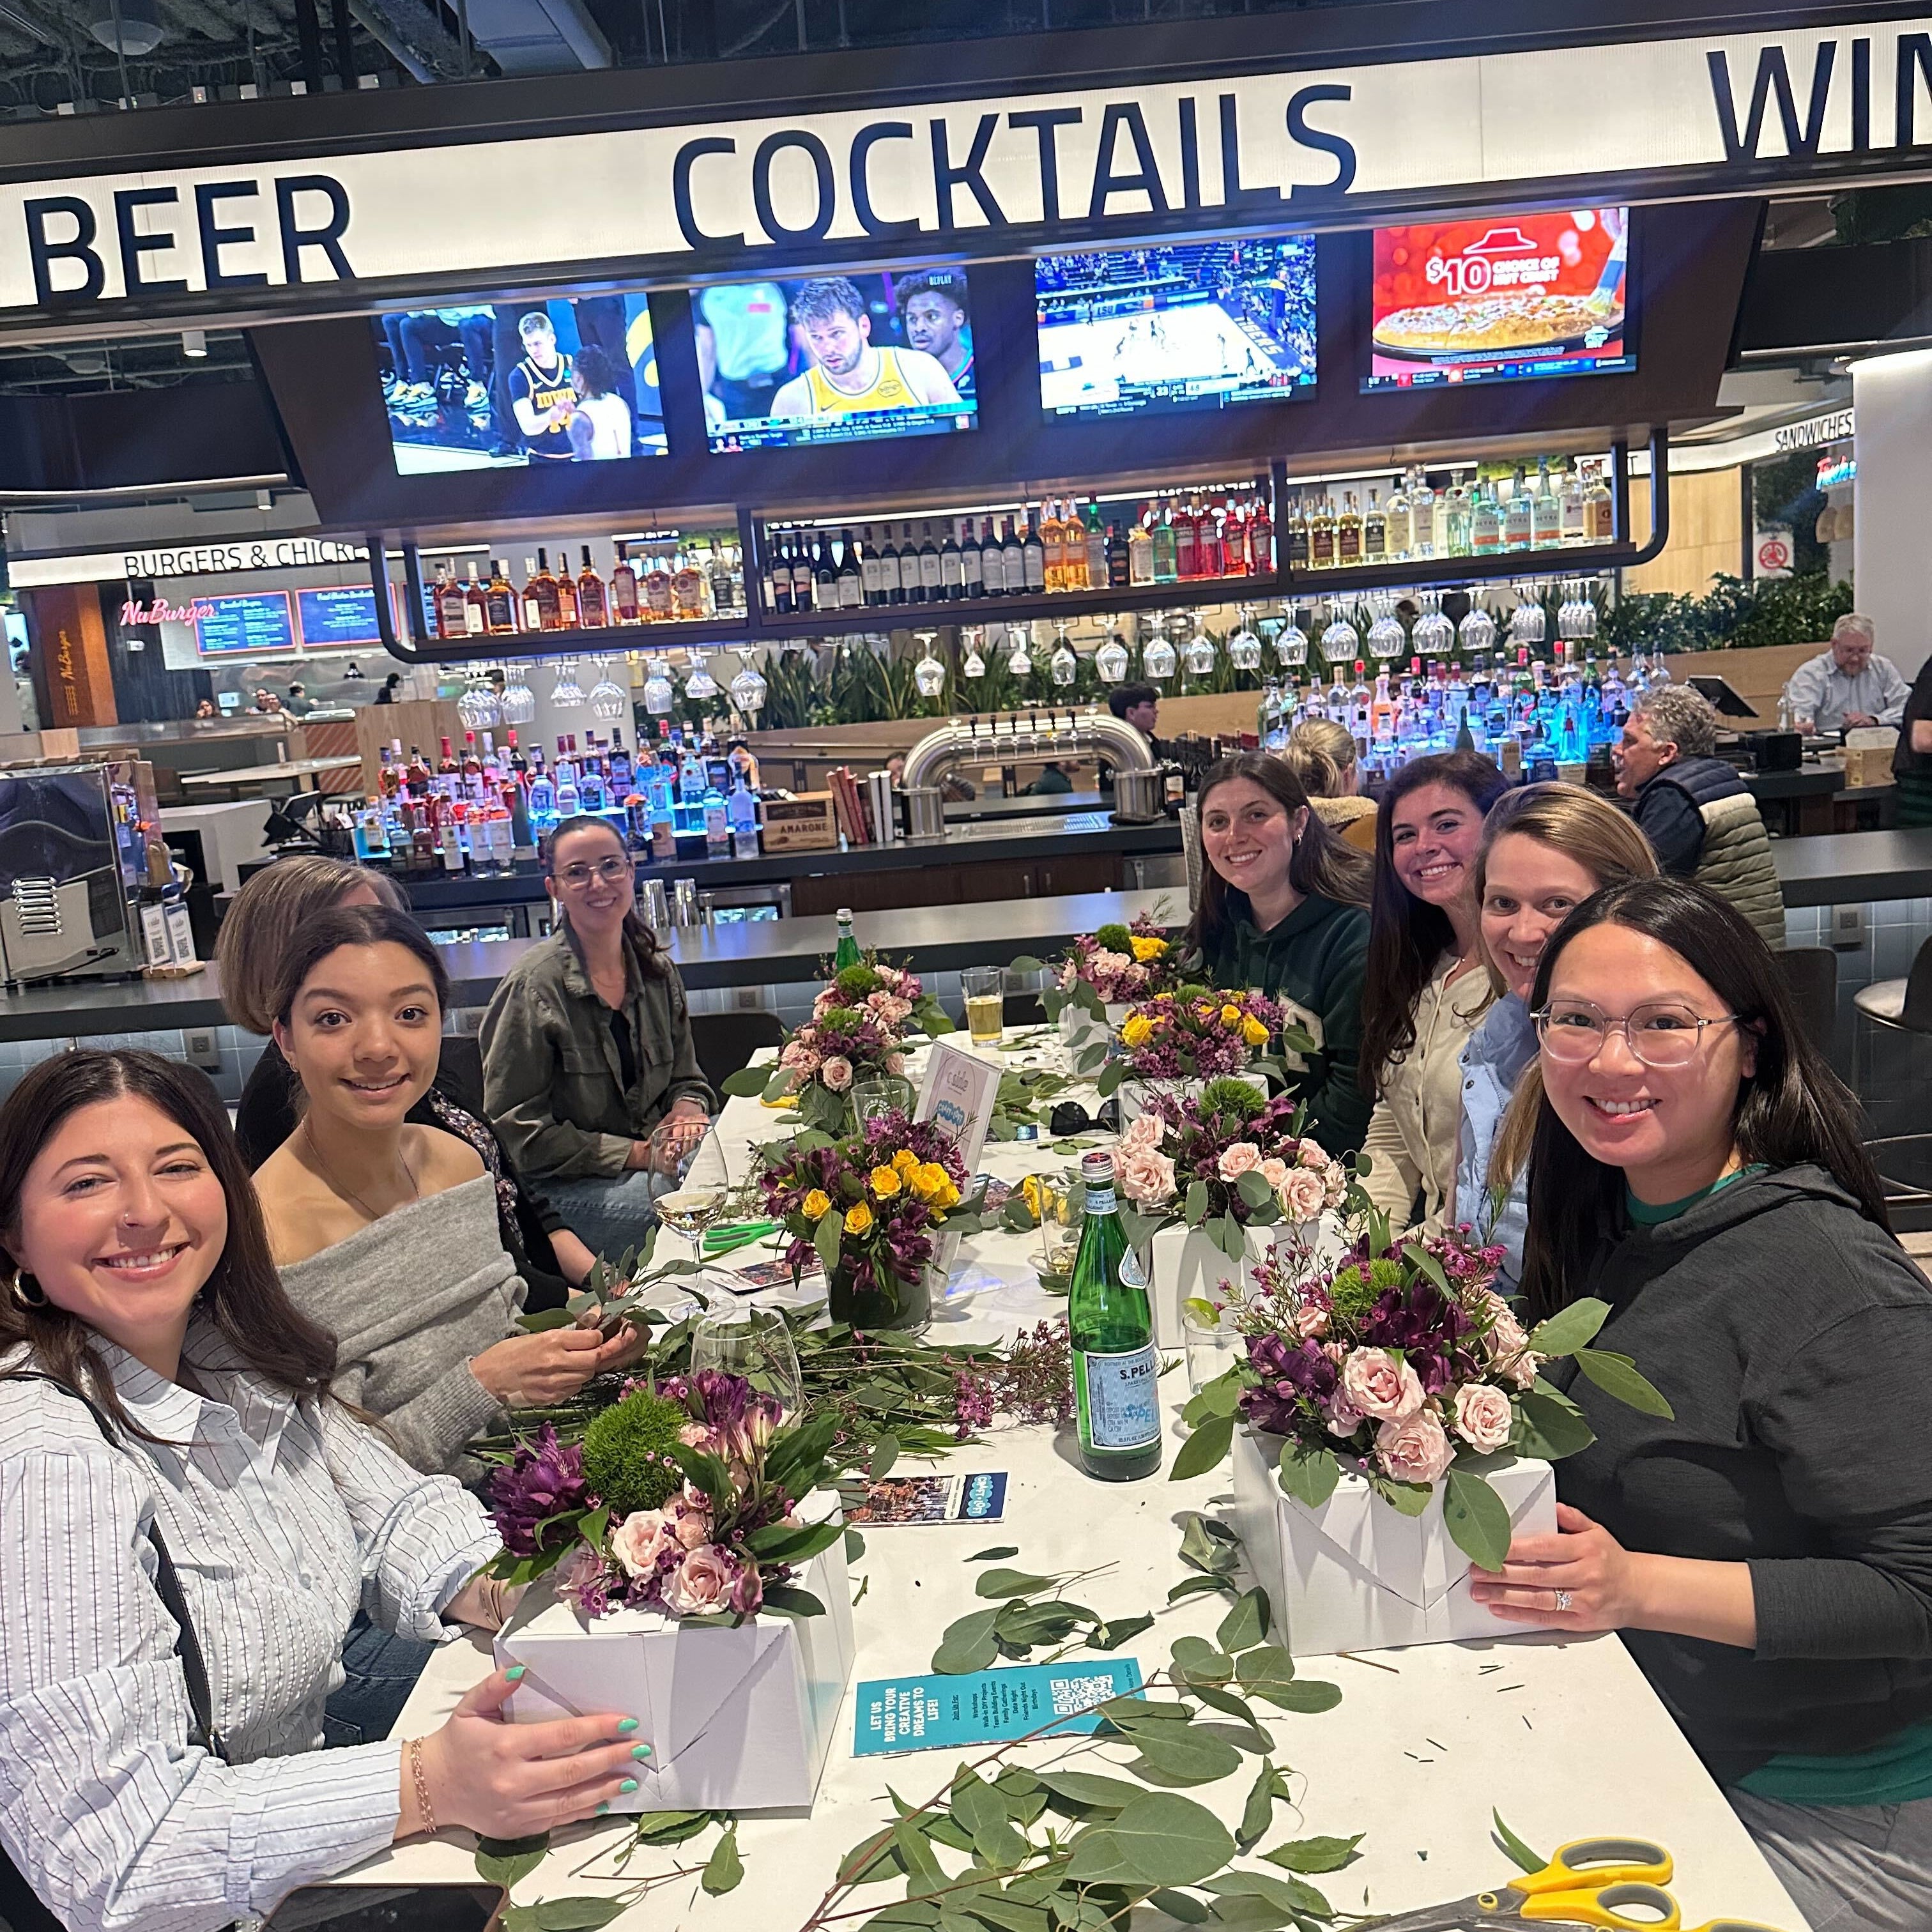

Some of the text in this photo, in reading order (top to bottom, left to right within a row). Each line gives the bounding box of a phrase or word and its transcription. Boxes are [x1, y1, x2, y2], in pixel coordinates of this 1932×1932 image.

[23, 174, 358, 306] BEER
[673, 84, 1356, 250] COCKTAILS
[1425, 256, 1492, 295] $10
[536, 387, 577, 408] IOWA
[1775, 412, 1853, 453] SANDWICHES
[124, 546, 242, 578] BURGERS
[250, 545, 269, 567] &
[119, 599, 215, 627] NuBurger
[781, 823, 827, 834] AMARONE
[870, 1701, 882, 1730] LET US
[884, 1687, 896, 1742] BRING YOUR
[898, 1691, 910, 1735] CREATIVE
[913, 1687, 925, 1736] DREAMS TO
[927, 1699, 939, 1721] LIFE!
